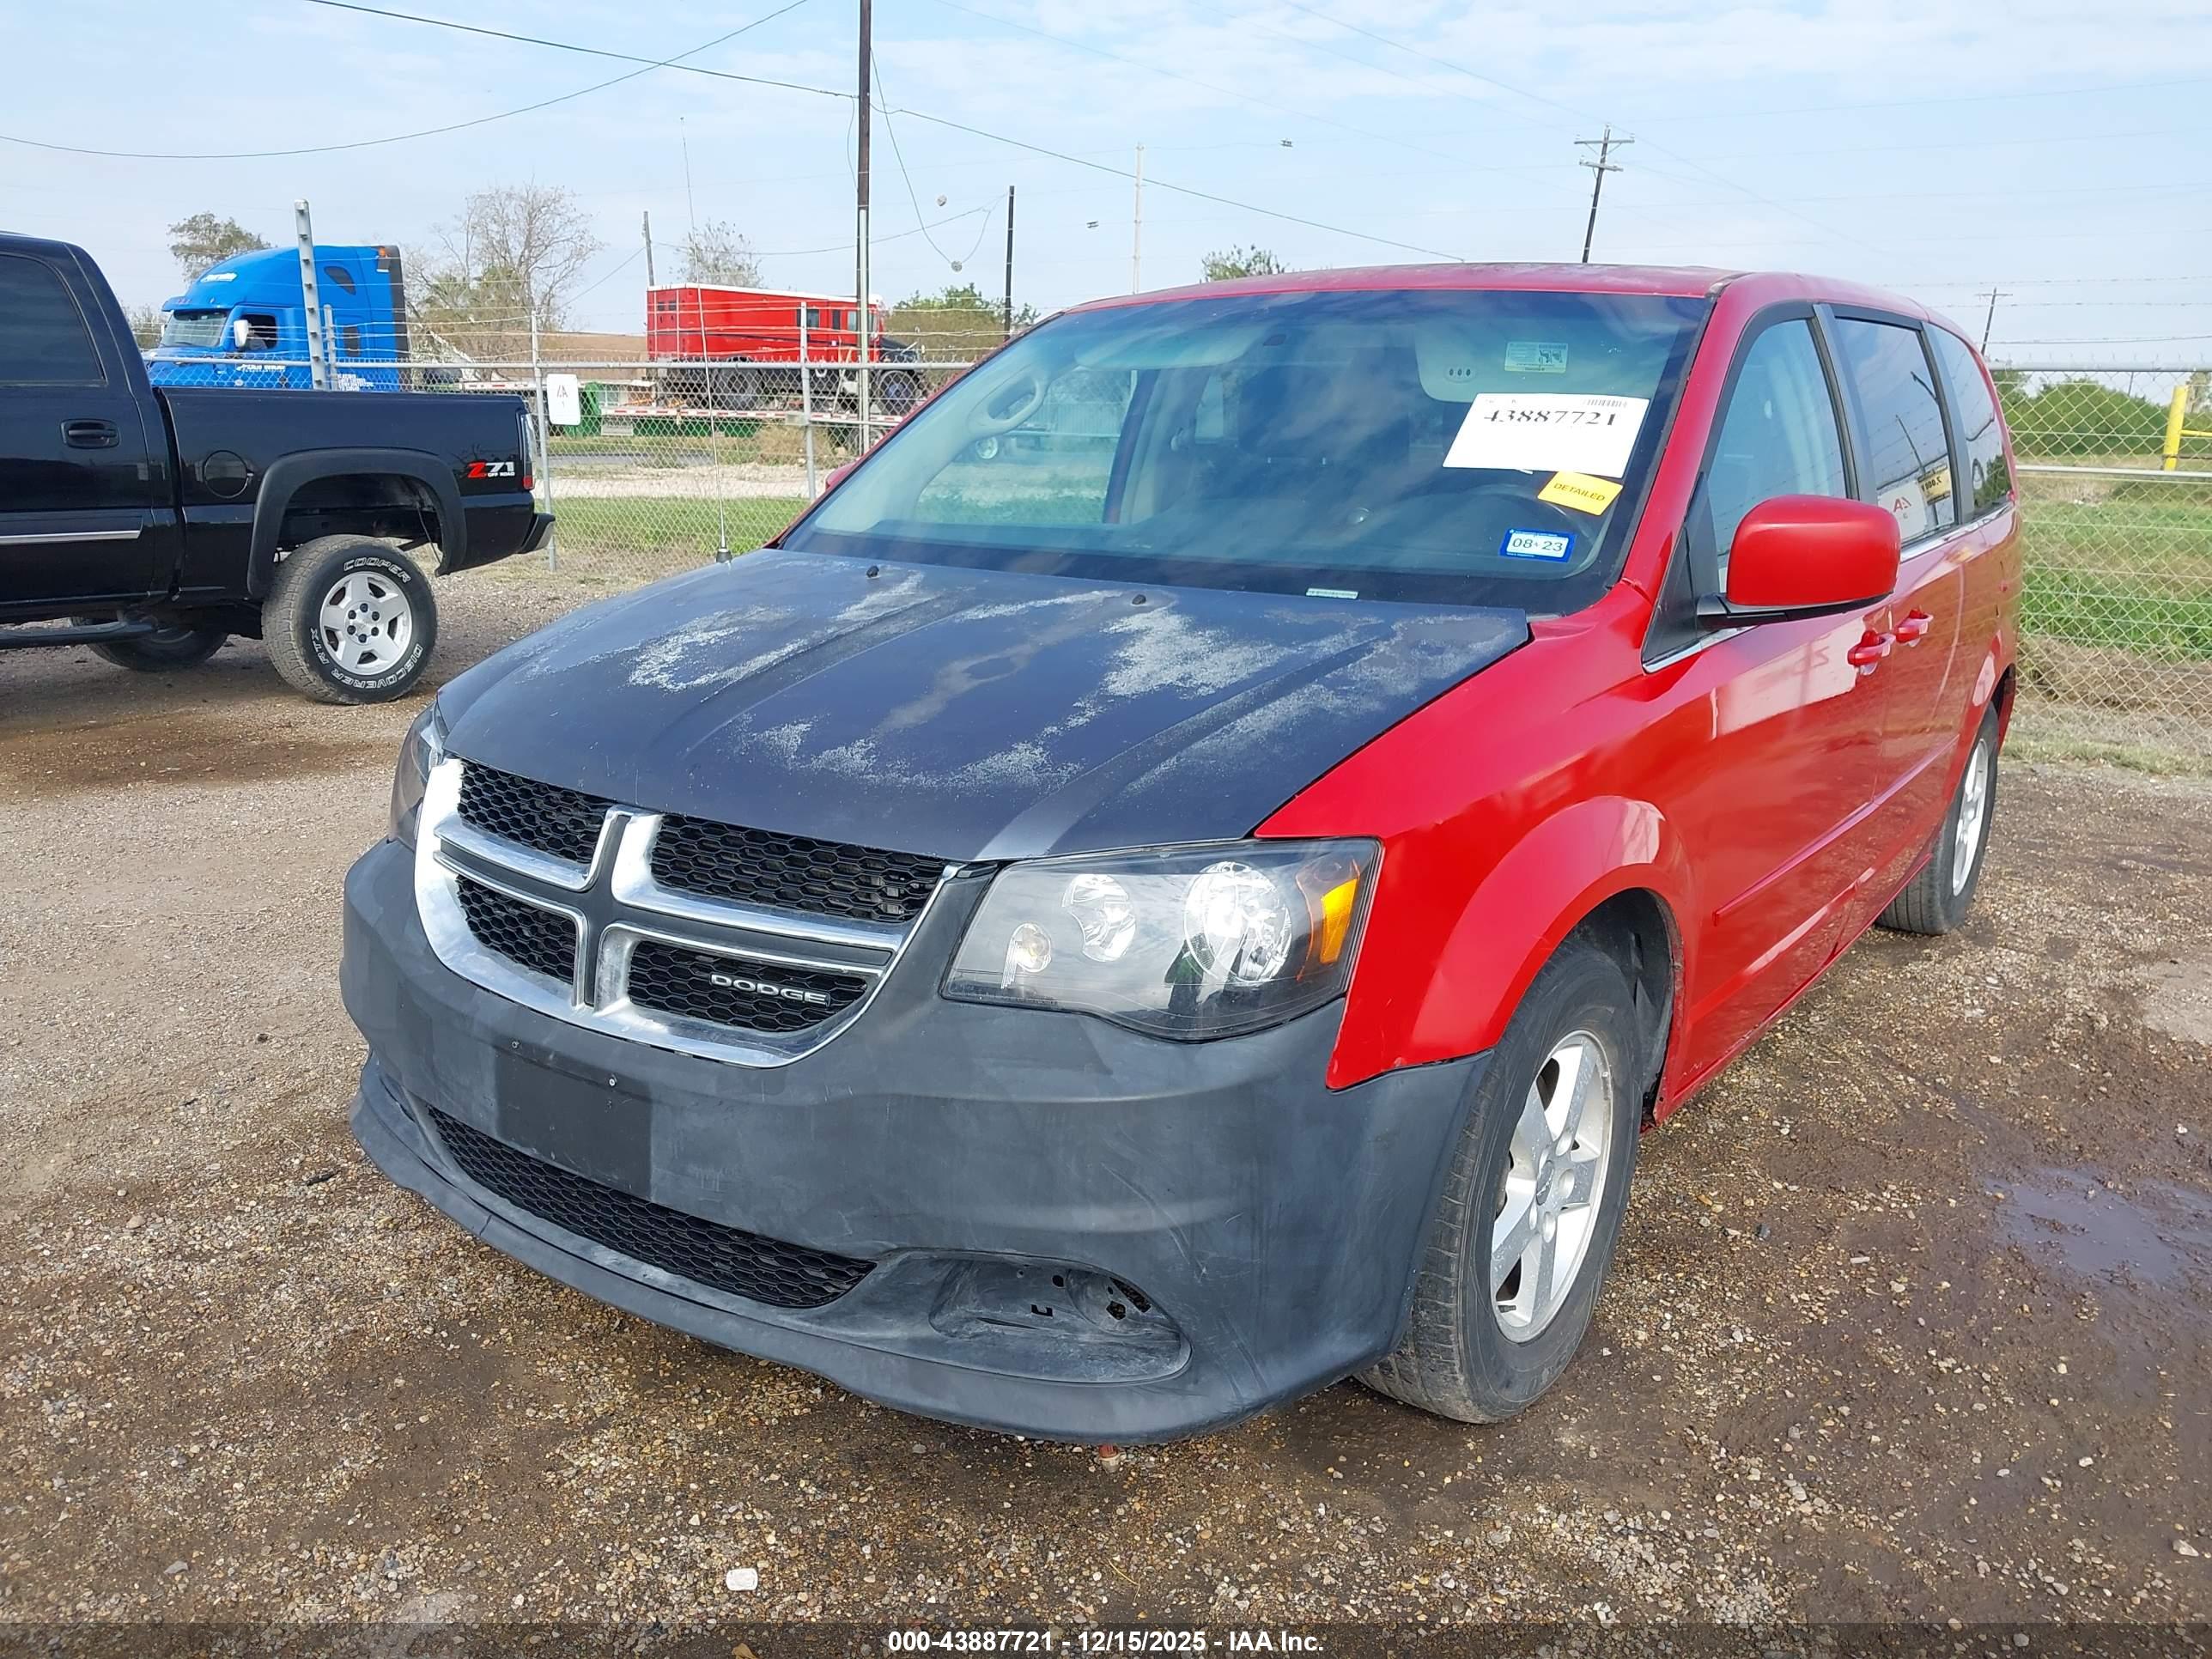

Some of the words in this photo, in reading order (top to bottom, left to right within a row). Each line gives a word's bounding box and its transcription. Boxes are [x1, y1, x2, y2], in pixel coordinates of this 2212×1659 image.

[1483, 410, 1617, 426] 43887721
[467, 461, 514, 478] Z71
[1553, 483, 1606, 501] DETAILED
[343, 556, 412, 583] COOPER
[310, 628, 330, 665] RTX
[331, 643, 423, 689] DISCOVERER
[711, 974, 828, 1006] DODGE
